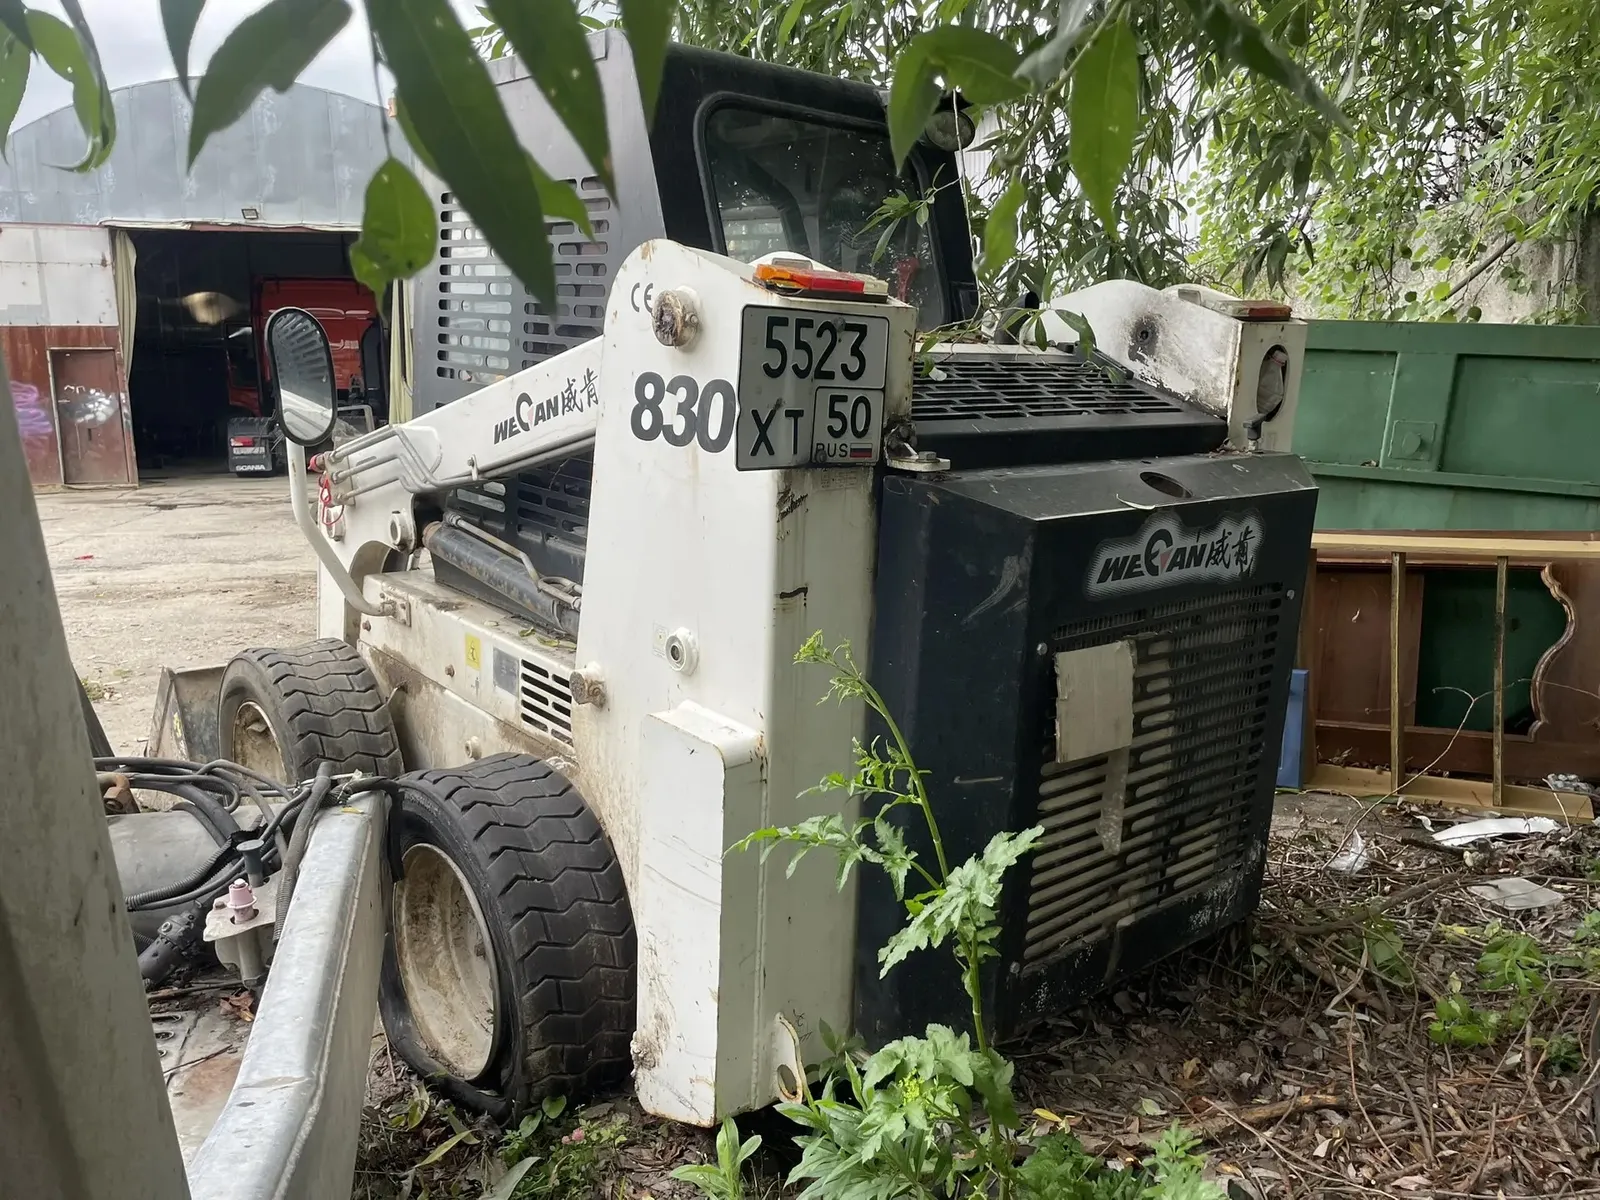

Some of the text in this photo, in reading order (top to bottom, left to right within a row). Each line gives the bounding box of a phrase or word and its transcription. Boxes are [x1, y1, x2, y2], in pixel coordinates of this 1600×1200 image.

[762, 316, 868, 381] 5523
[494, 392, 559, 445] WECAN
[631, 371, 737, 454] 830
[827, 394, 872, 439] 50
[235, 464, 266, 472] SCANIA
[815, 442, 848, 458] RUS
